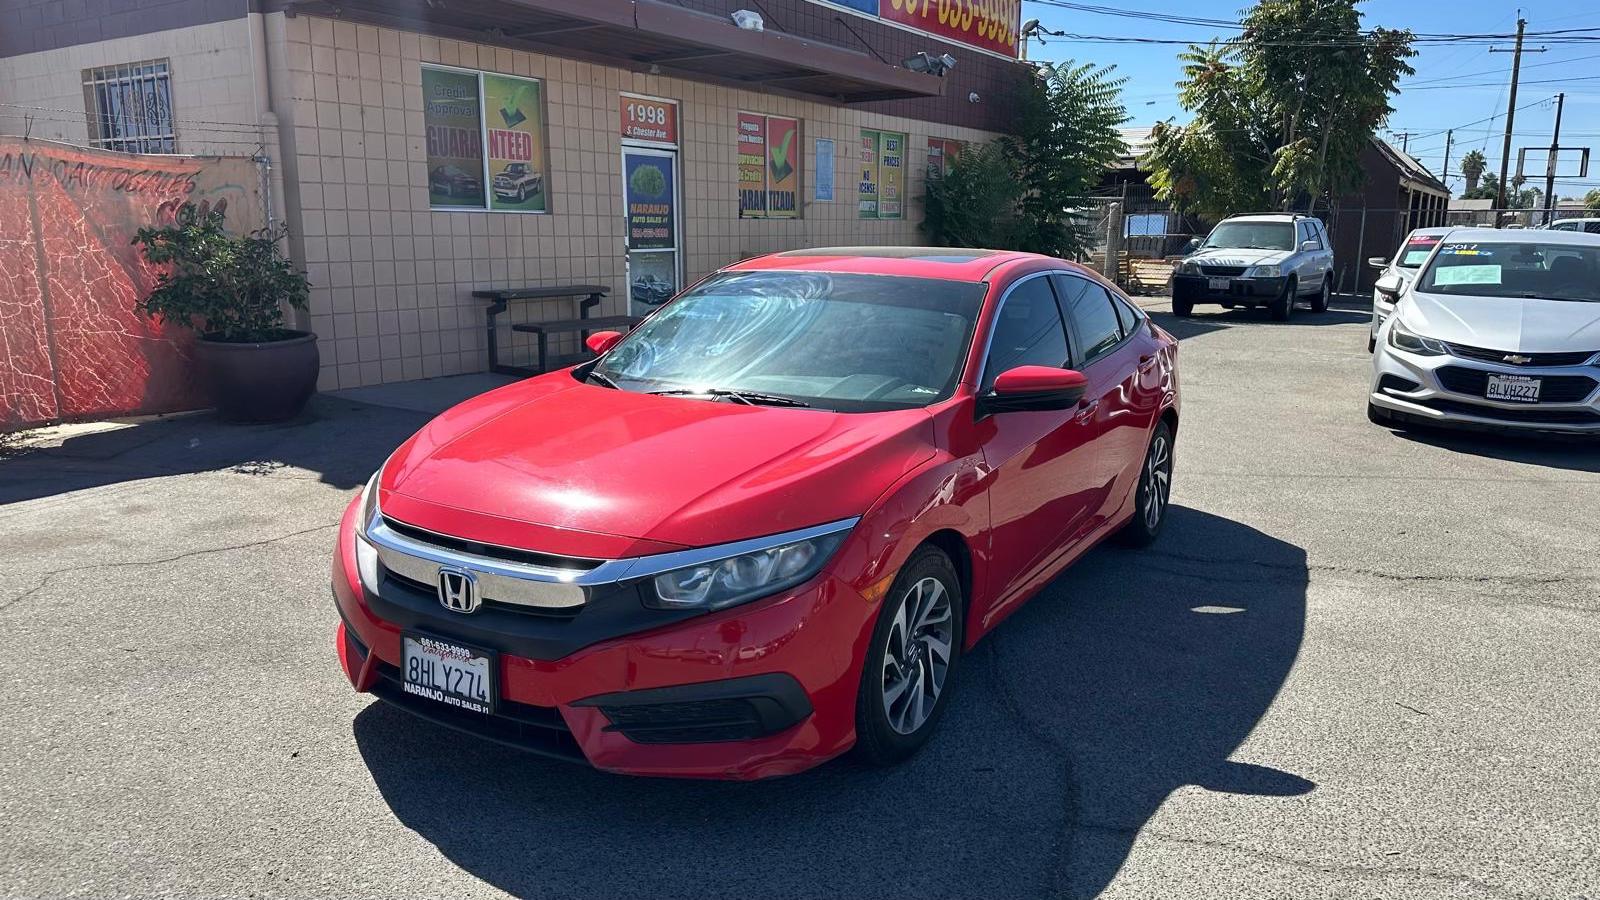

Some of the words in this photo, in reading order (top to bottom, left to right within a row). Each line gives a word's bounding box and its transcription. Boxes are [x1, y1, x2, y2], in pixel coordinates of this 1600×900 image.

[434, 84, 466, 98] Credit
[427, 102, 476, 118] Approval
[627, 103, 666, 125] 1998
[633, 127, 655, 137] Chester
[427, 125, 532, 161] GUARANTEED
[887, 140, 898, 151] BEST
[884, 155, 900, 167] PRICES
[863, 170, 870, 181] NO
[631, 203, 669, 214] NARANJO
[646, 216, 661, 224] SALES
[1489, 383, 1538, 398] 8LVH227
[420, 637, 471, 658] 661-633-9999
[409, 656, 487, 702] 8HLY274
[404, 682, 444, 702] NARANJO
[444, 696, 461, 708] AUTO
[461, 699, 482, 713] SALES
